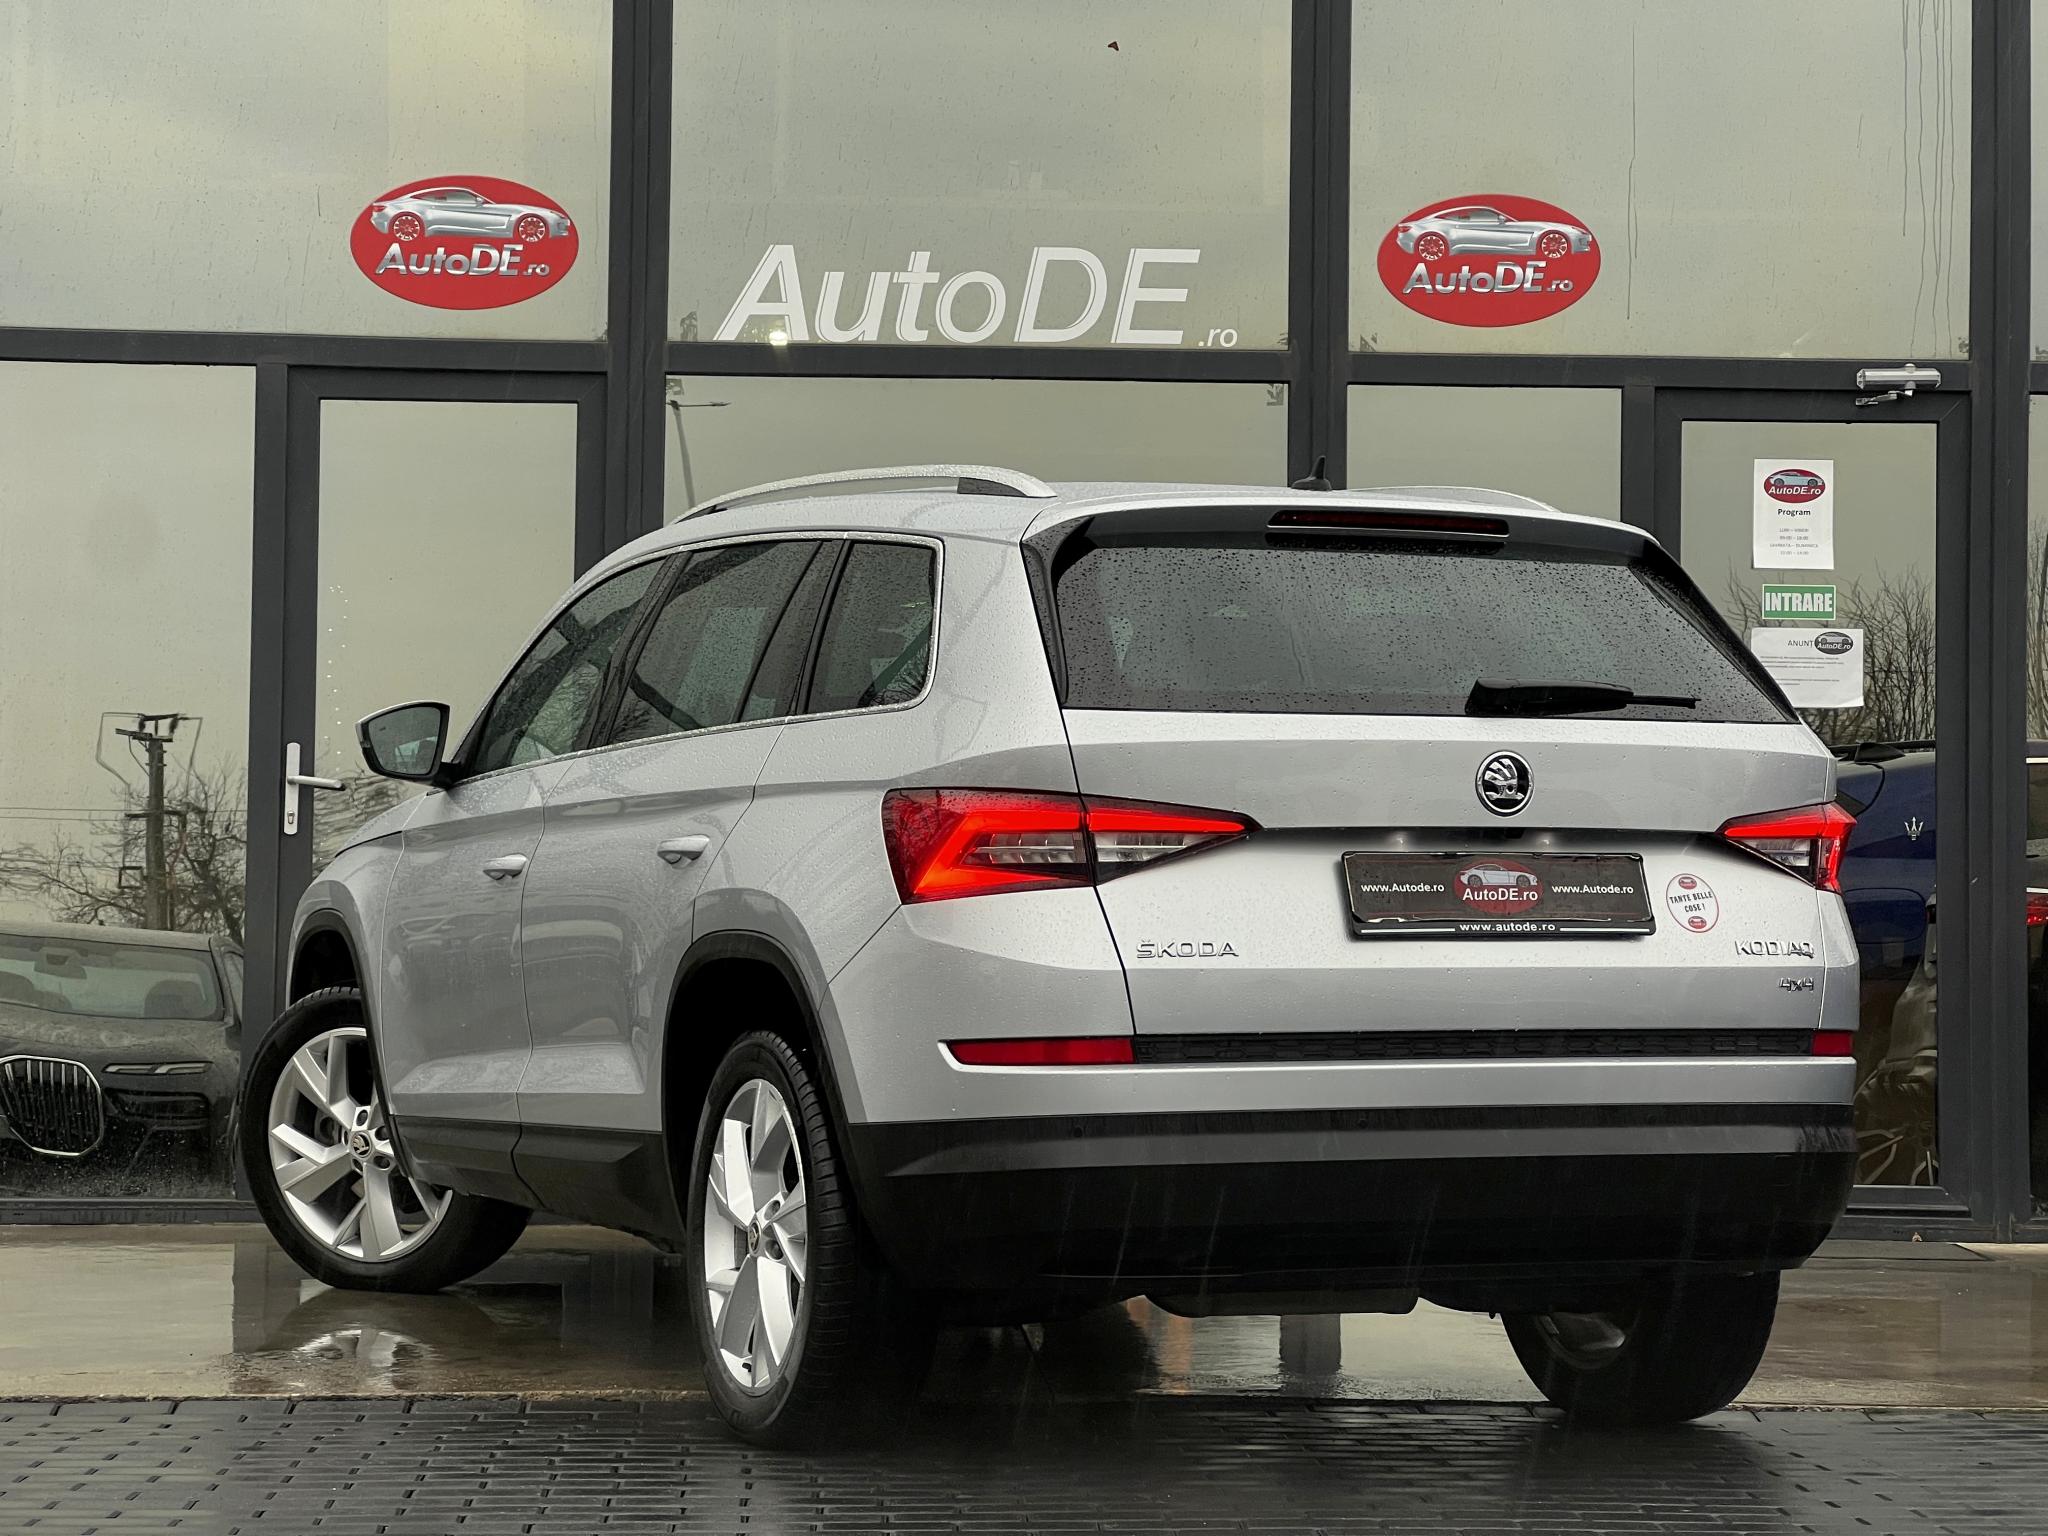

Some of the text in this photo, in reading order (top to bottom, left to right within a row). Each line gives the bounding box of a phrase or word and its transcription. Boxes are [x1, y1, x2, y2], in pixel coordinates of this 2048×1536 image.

[1768, 486, 1822, 495] AutoDE.ro
[1777, 508, 1811, 517] Program
[1765, 592, 1833, 612] INTRARE
[1360, 882, 1445, 893] www.Autode.ro
[1462, 887, 1539, 901] AutoDE.ro
[1551, 885, 1634, 895] www.Autode.ro
[1669, 891, 1713, 904] TANTE BELLE
[1459, 922, 1556, 932] www.autode.ro
[1136, 938, 1240, 959] ŠKODA
[1734, 940, 1815, 959] KODIAQ
[1779, 977, 1815, 992] 4x4
